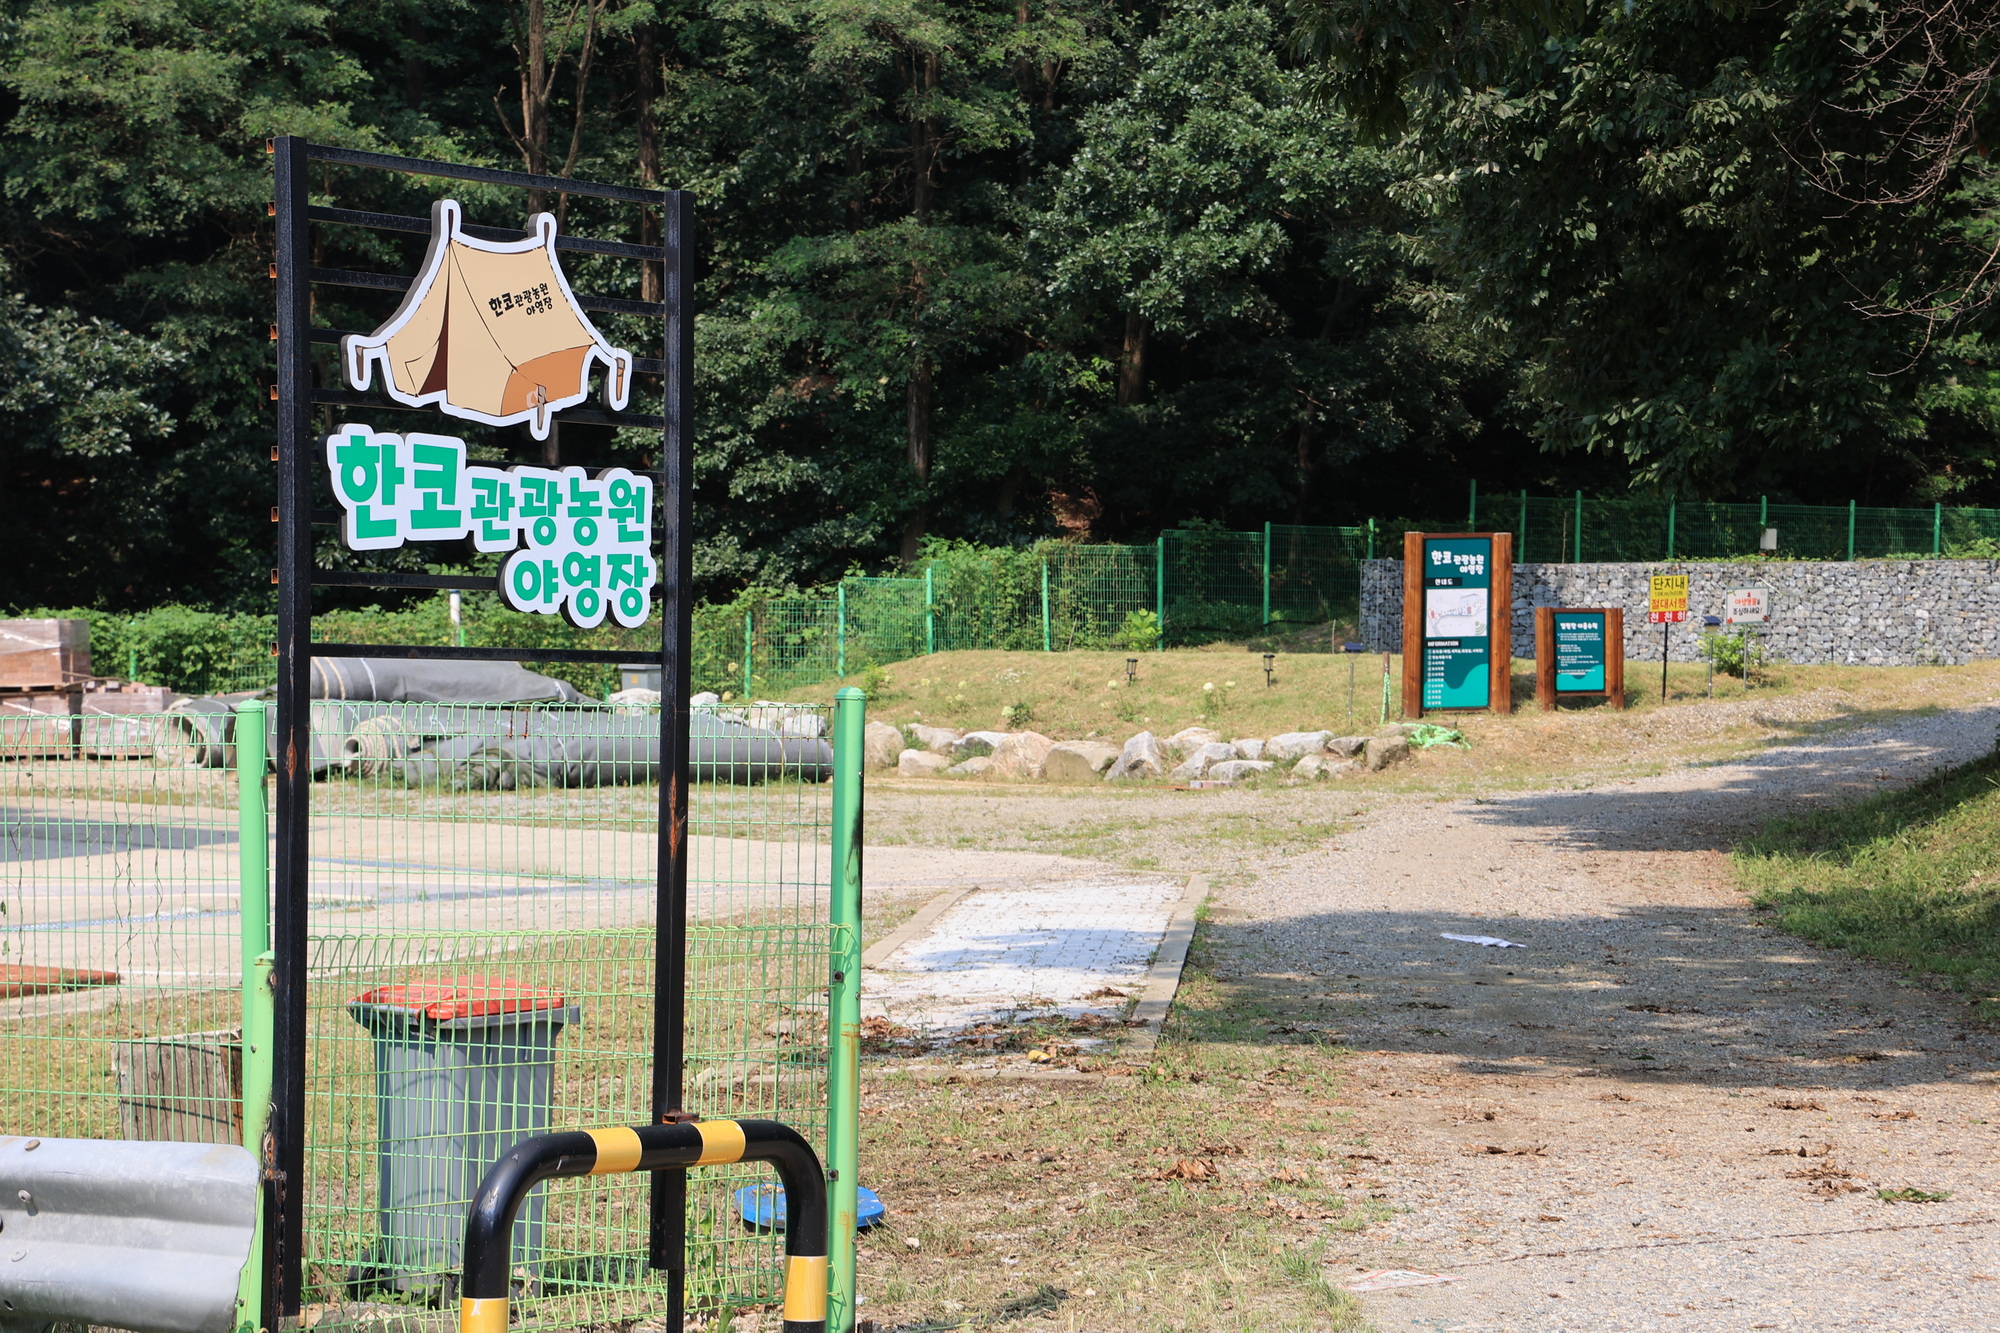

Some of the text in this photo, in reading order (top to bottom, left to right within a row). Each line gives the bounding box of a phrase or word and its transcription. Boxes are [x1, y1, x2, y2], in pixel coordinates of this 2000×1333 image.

[526, 296, 553, 316] 야영장
[1459, 565, 1484, 575] 야영장
[513, 551, 649, 618] 야영장
[1653, 576, 1685, 590] 단지내
[1651, 597, 1686, 610] 절대서행
